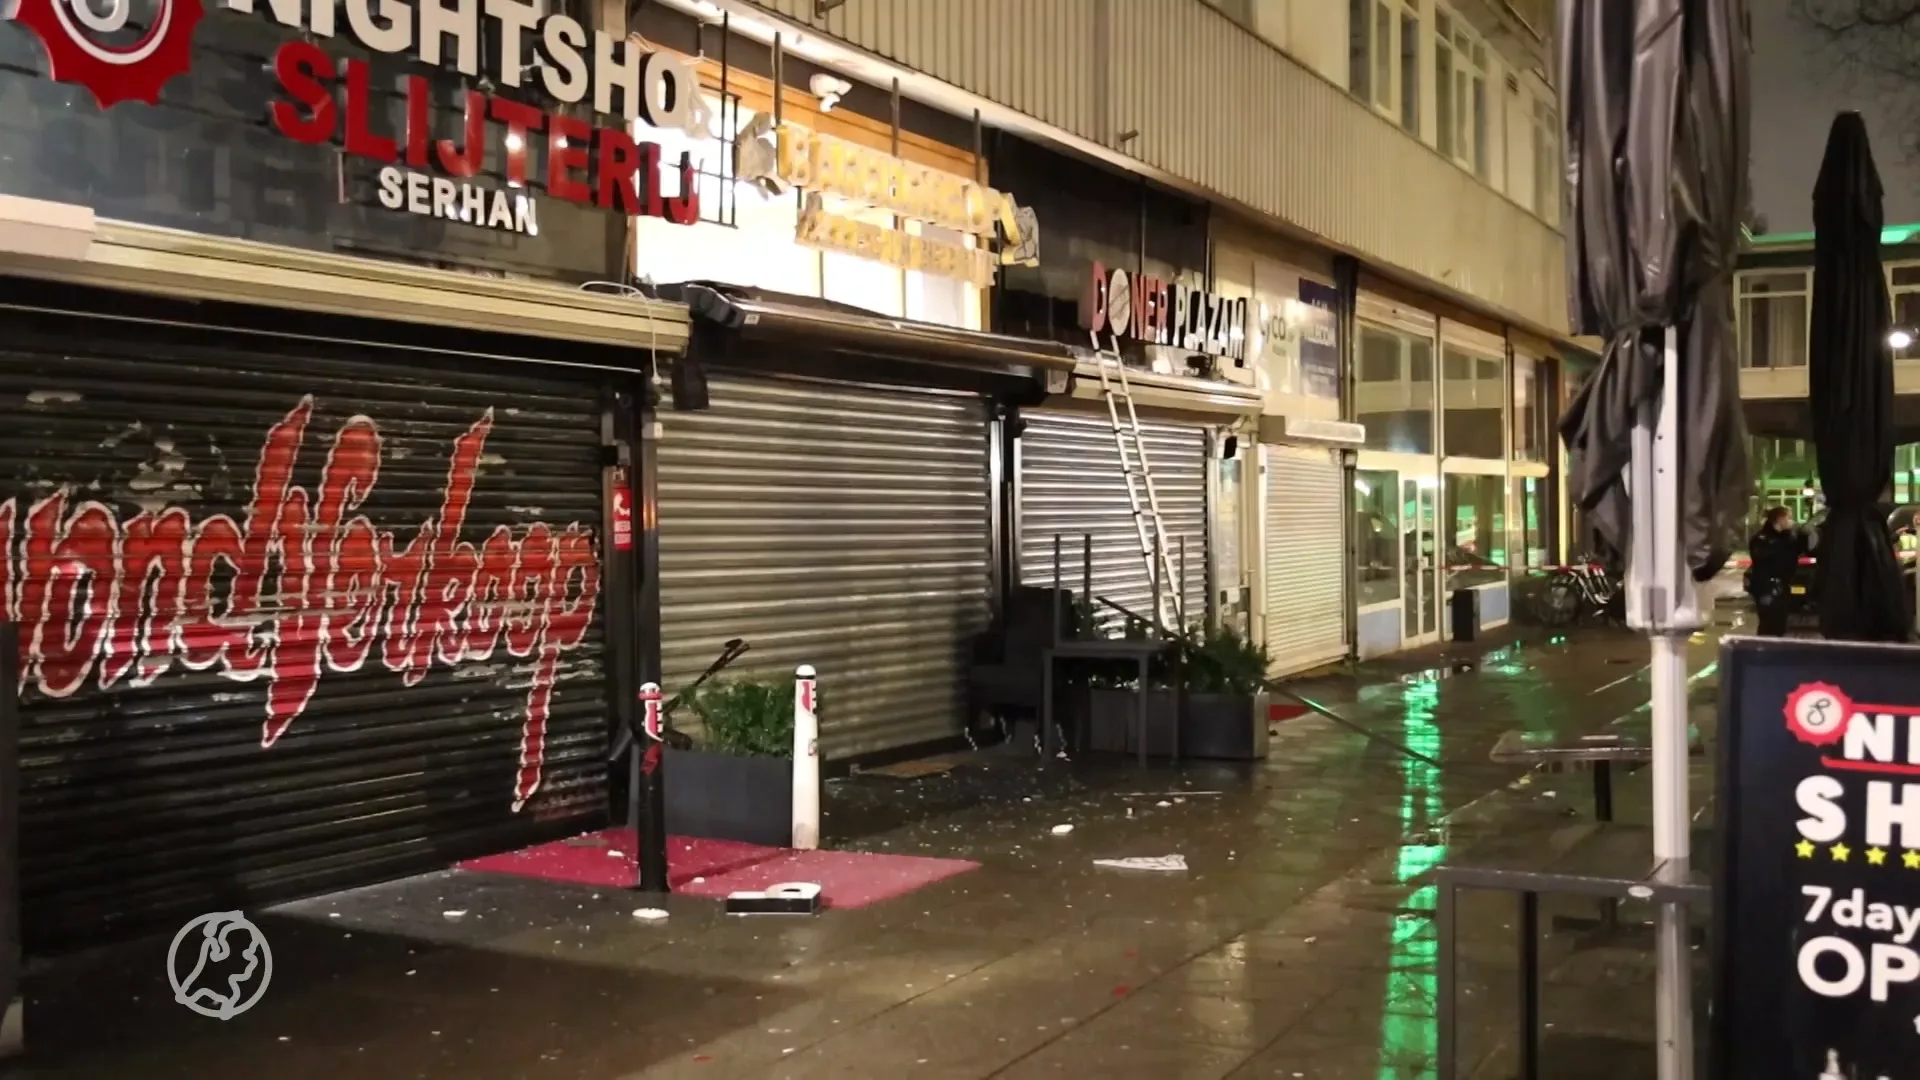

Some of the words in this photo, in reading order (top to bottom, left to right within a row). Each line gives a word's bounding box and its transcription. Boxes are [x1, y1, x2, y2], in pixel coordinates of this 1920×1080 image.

[270, 42, 700, 225] SLIJTERIJ
[378, 166, 539, 236] SERHAN
[1795, 775, 1920, 850] SH
[1797, 936, 1920, 1002] OP
